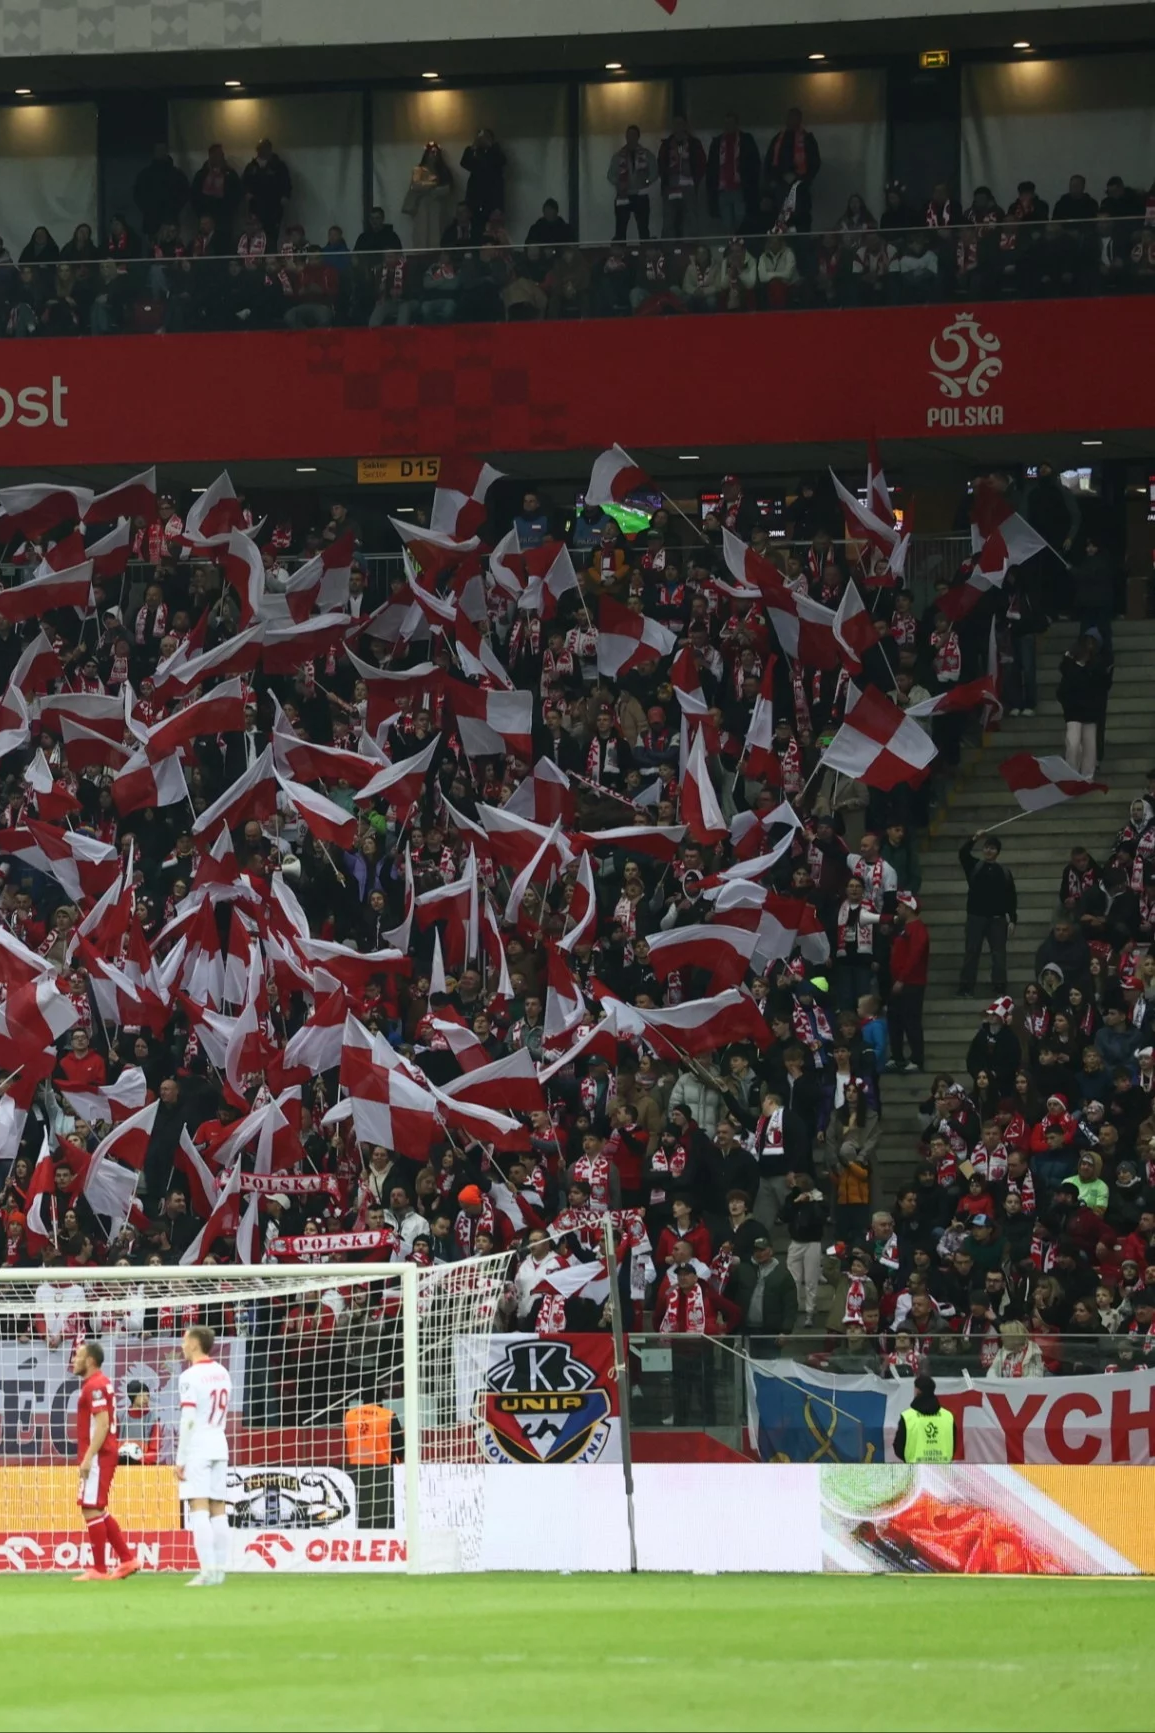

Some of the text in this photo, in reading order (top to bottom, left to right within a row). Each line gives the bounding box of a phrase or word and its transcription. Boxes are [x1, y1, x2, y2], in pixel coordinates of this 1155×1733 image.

[926, 404, 1004, 428] POLSKA
[400, 460, 438, 477] D15
[240, 1175, 317, 1191] POLSKA
[298, 1233, 375, 1251] POLSKA
[208, 1388, 228, 1426] 19
[501, 1397, 582, 1411] UNIA
[305, 1539, 408, 1562] ORLEN
